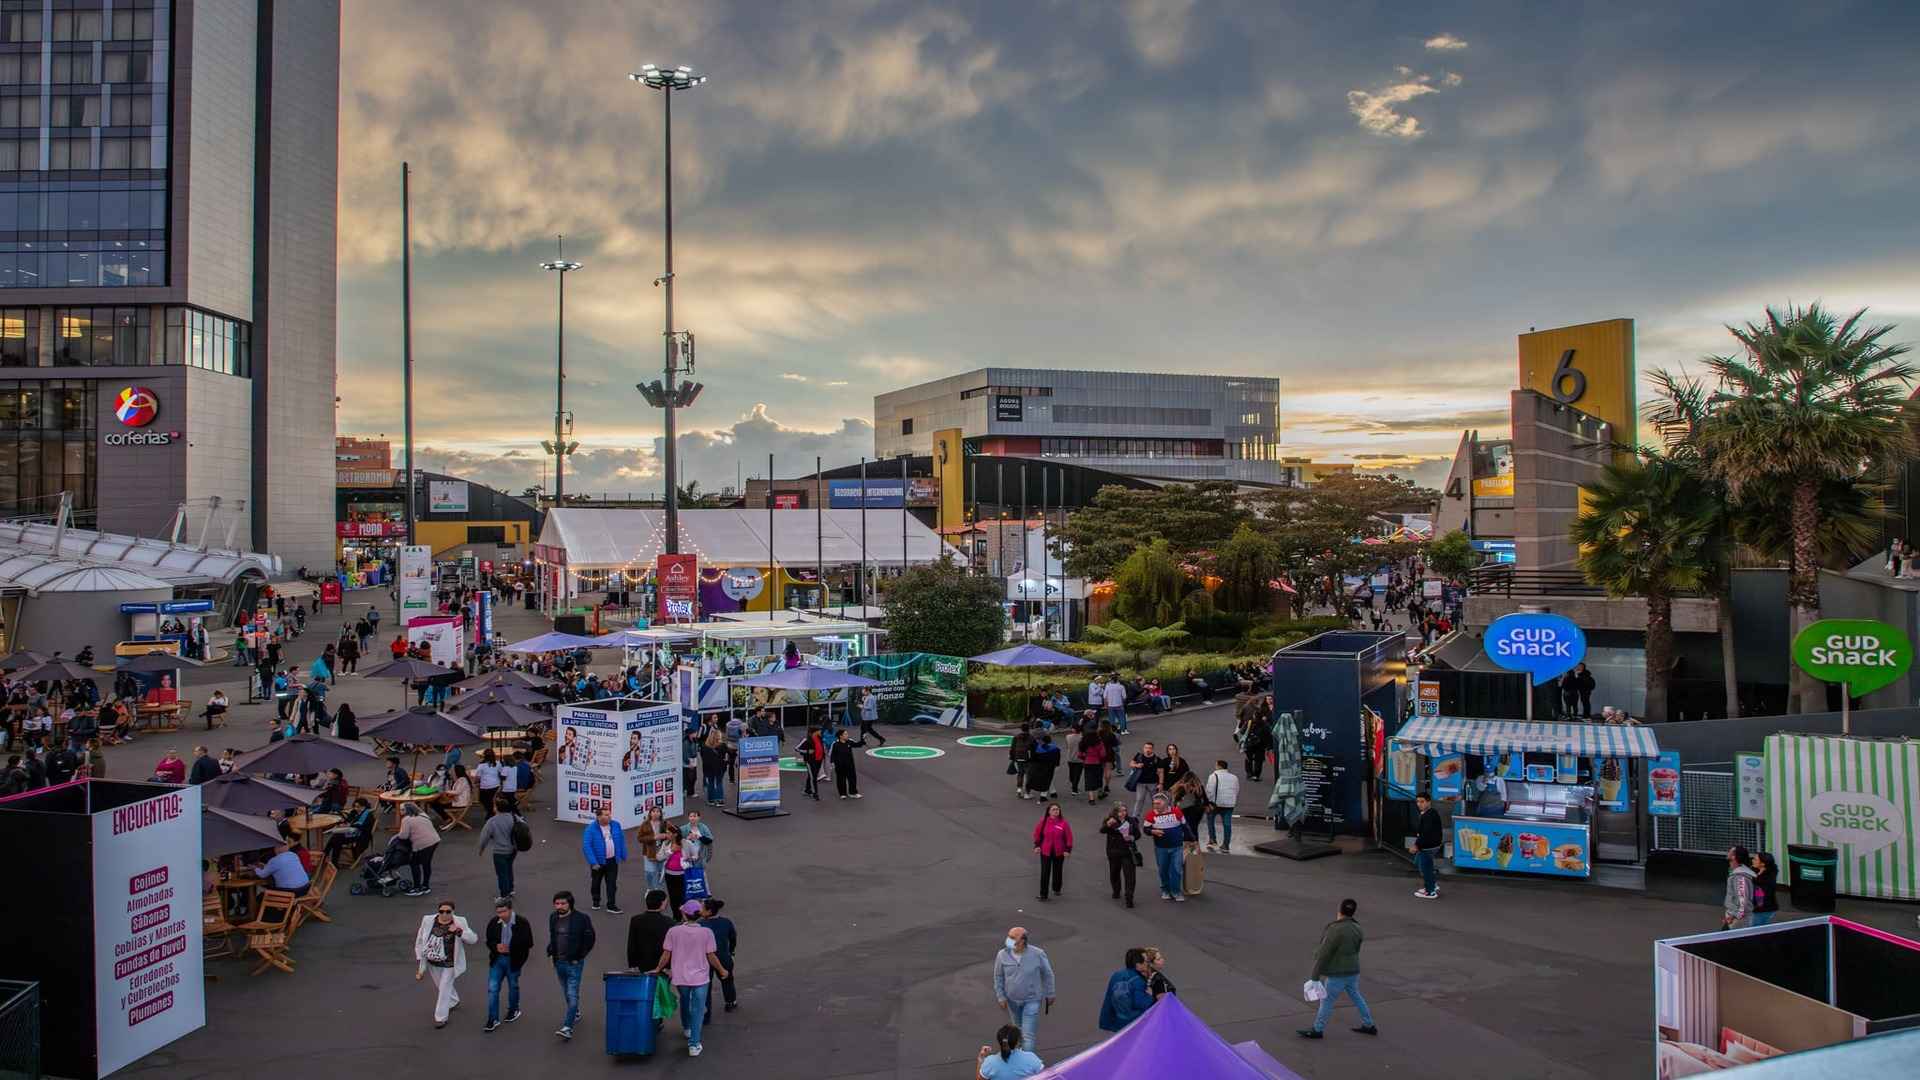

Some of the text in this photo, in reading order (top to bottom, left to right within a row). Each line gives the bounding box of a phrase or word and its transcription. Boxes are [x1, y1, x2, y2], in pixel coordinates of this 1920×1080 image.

[1552, 349, 1585, 403] 6
[105, 429, 169, 445] corferias
[1446, 477, 1464, 501] 4
[1510, 628, 1556, 642] GUD
[1826, 634, 1880, 650] GUD
[113, 794, 183, 836] ENCUENTRA:
[1832, 803, 1875, 818] GUD
[127, 887, 174, 913] Almohadas
[155, 919, 186, 940] Mantas
[116, 937, 185, 977] Fundas de Duvet
[121, 973, 180, 1011] y Cubrelechos
[130, 995, 172, 1025] Plumones
